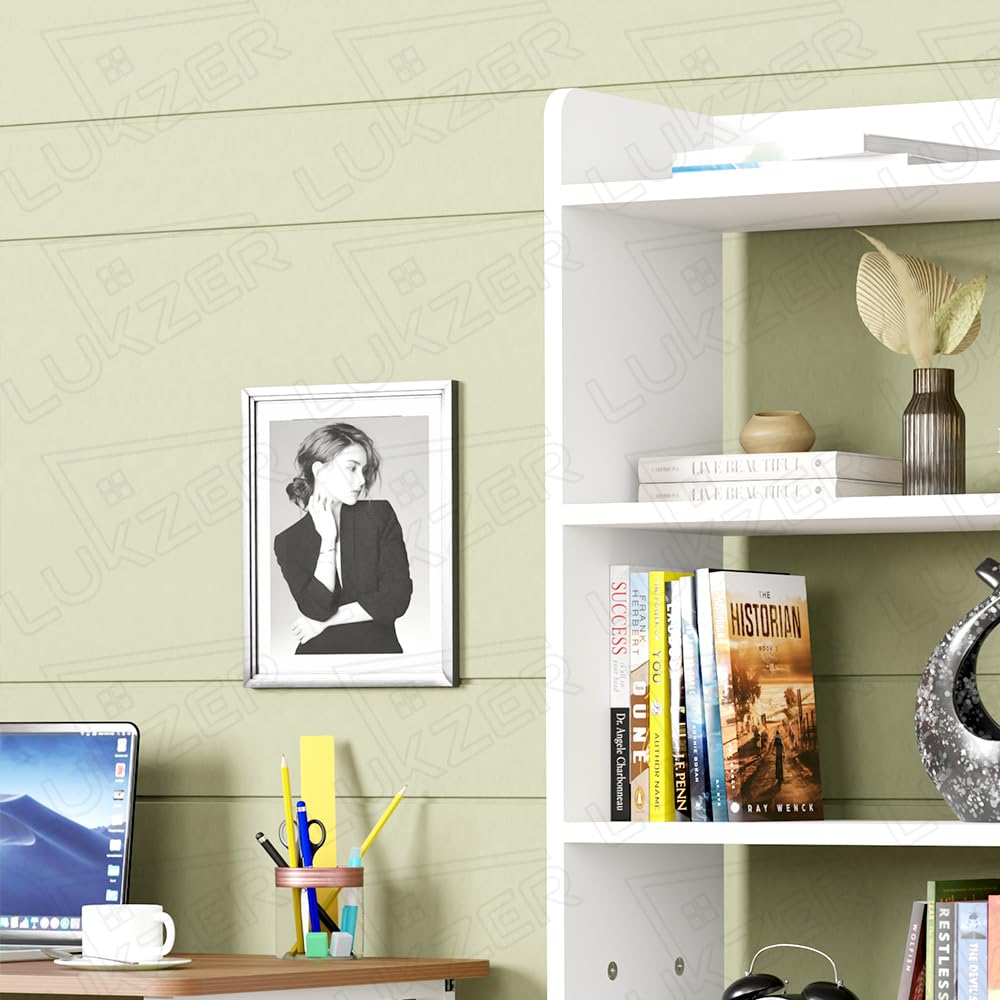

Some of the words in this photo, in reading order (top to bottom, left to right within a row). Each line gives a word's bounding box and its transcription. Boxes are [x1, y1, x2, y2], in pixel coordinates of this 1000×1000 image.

[759, 591, 770, 599] THE
[612, 582, 628, 655] SUCCESS
[730, 602, 802, 638] HISTORIAN
[652, 651, 661, 683] YOU
[616, 713, 626, 726] Dr.
[632, 680, 648, 764] DUNE
[614, 727, 626, 755] Angele
[616, 756, 626, 811] Charbonneau
[675, 771, 687, 811] PENN
[748, 804, 768, 813] RAY
[776, 803, 814, 813] WENCK
[905, 924, 918, 971] WOLFISH
[938, 908, 950, 1000] RESTLESS
[969, 944, 979, 961] THE
[969, 965, 979, 1000] DEVIL'S
